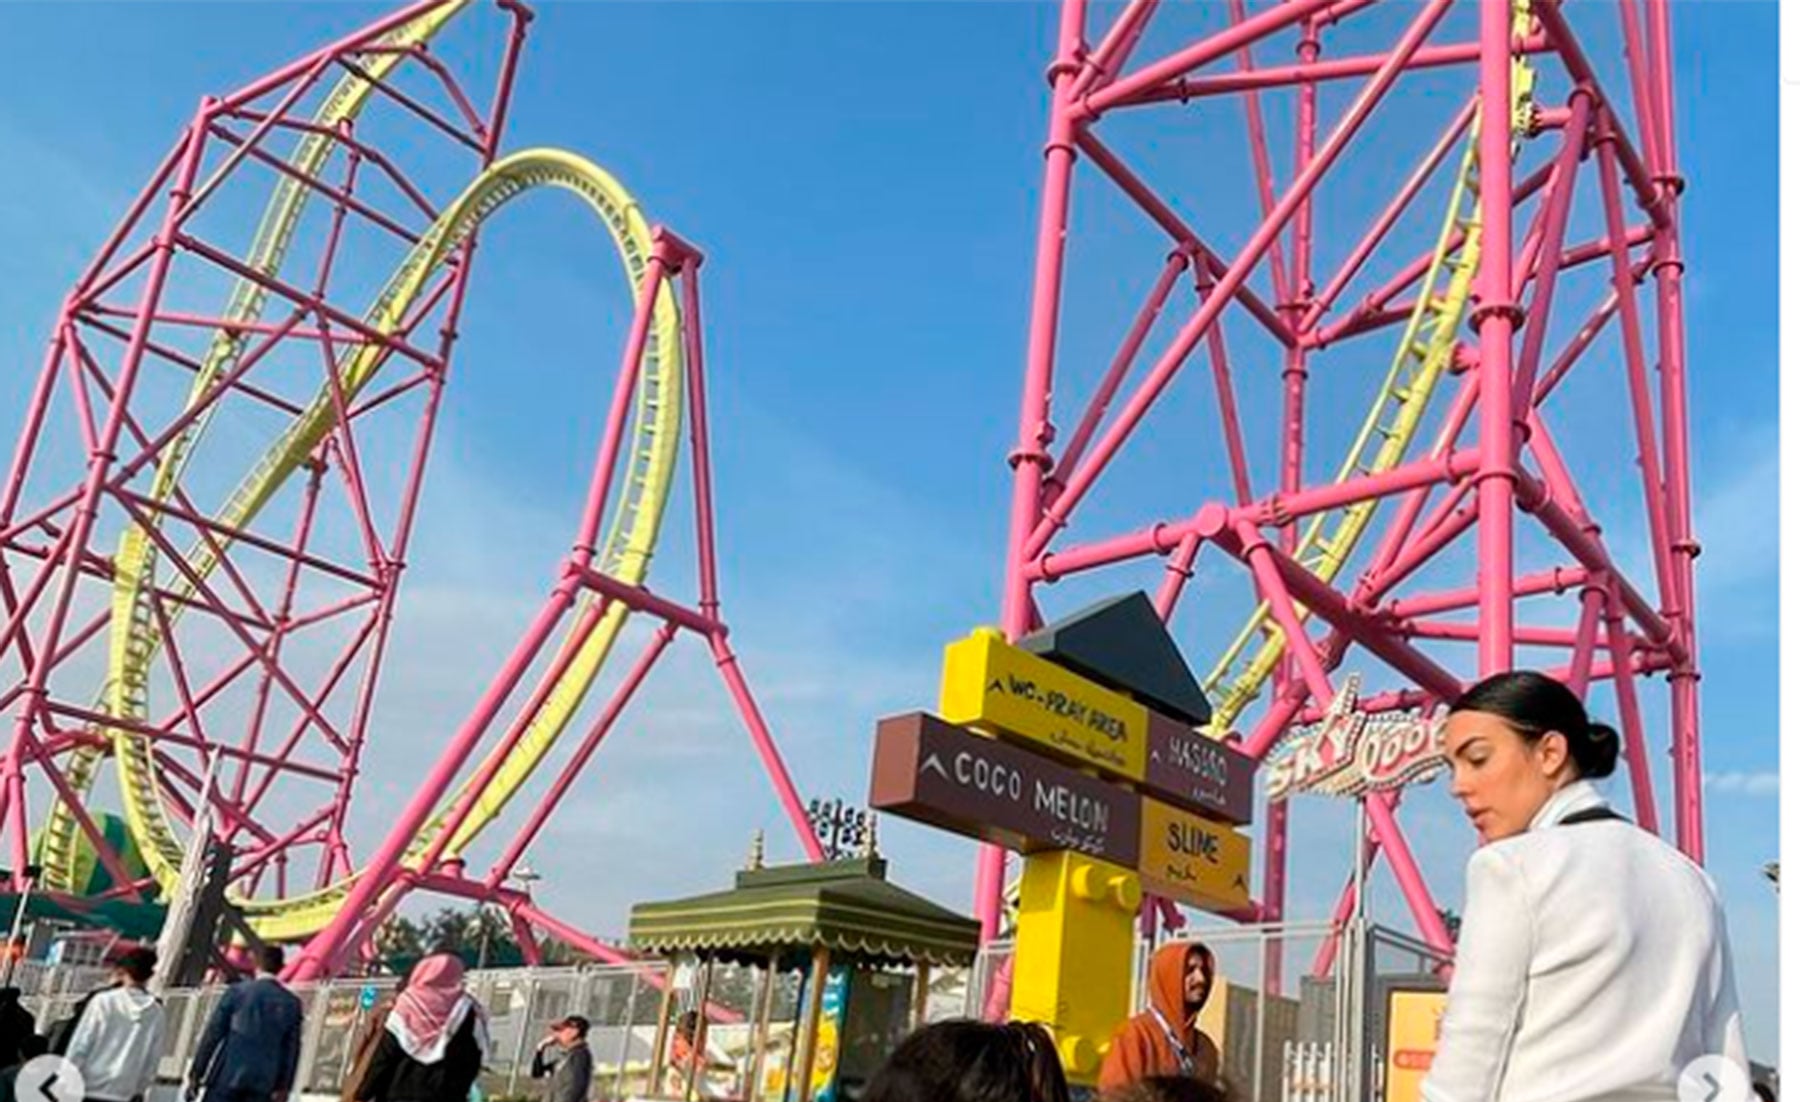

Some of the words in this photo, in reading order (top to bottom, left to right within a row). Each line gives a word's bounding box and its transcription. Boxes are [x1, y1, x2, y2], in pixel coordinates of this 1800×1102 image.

[953, 751, 1021, 801] COCO
[1034, 779, 1109, 832] MELON
[1167, 822, 1219, 865] SLIME
